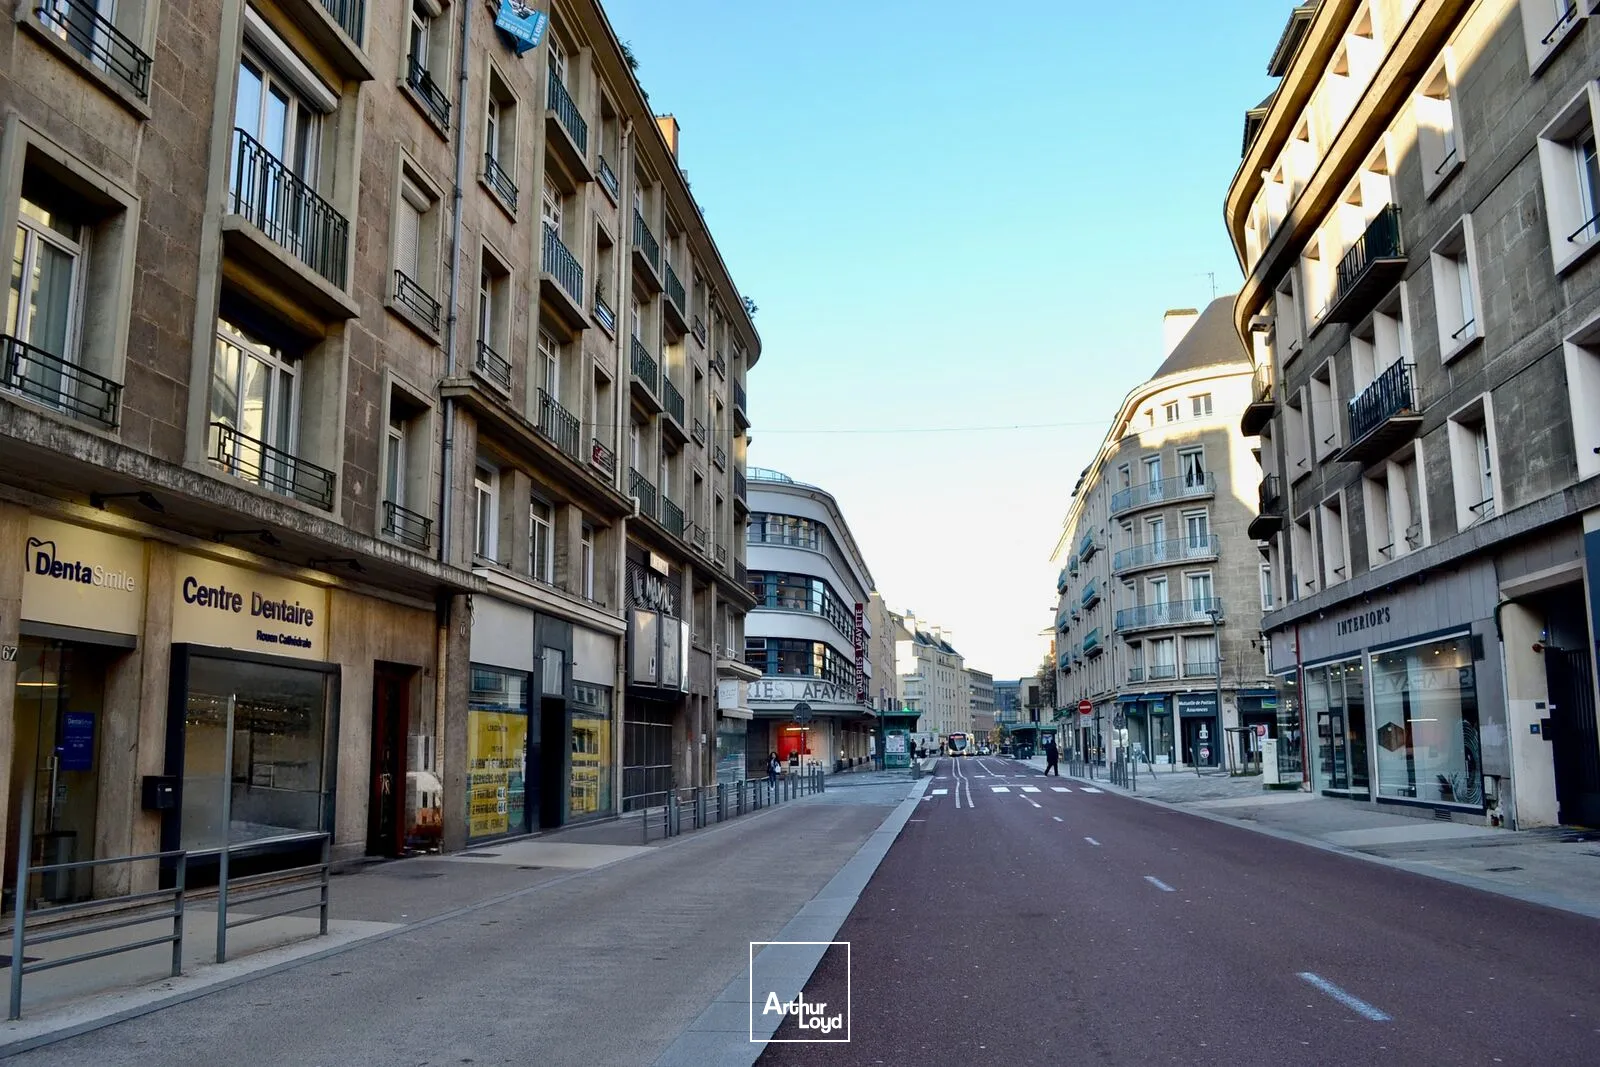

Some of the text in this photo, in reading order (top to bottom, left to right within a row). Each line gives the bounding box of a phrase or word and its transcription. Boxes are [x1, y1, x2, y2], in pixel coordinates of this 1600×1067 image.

[183, 576, 314, 627] Centre Dentaire
[256, 630, 278, 643] Rouen
[855, 609, 863, 651] LAFAYETTE
[1337, 606, 1391, 636] INTERIOR'S
[2, 645, 18, 661] 67
[856, 656, 864, 693] GALERIES
